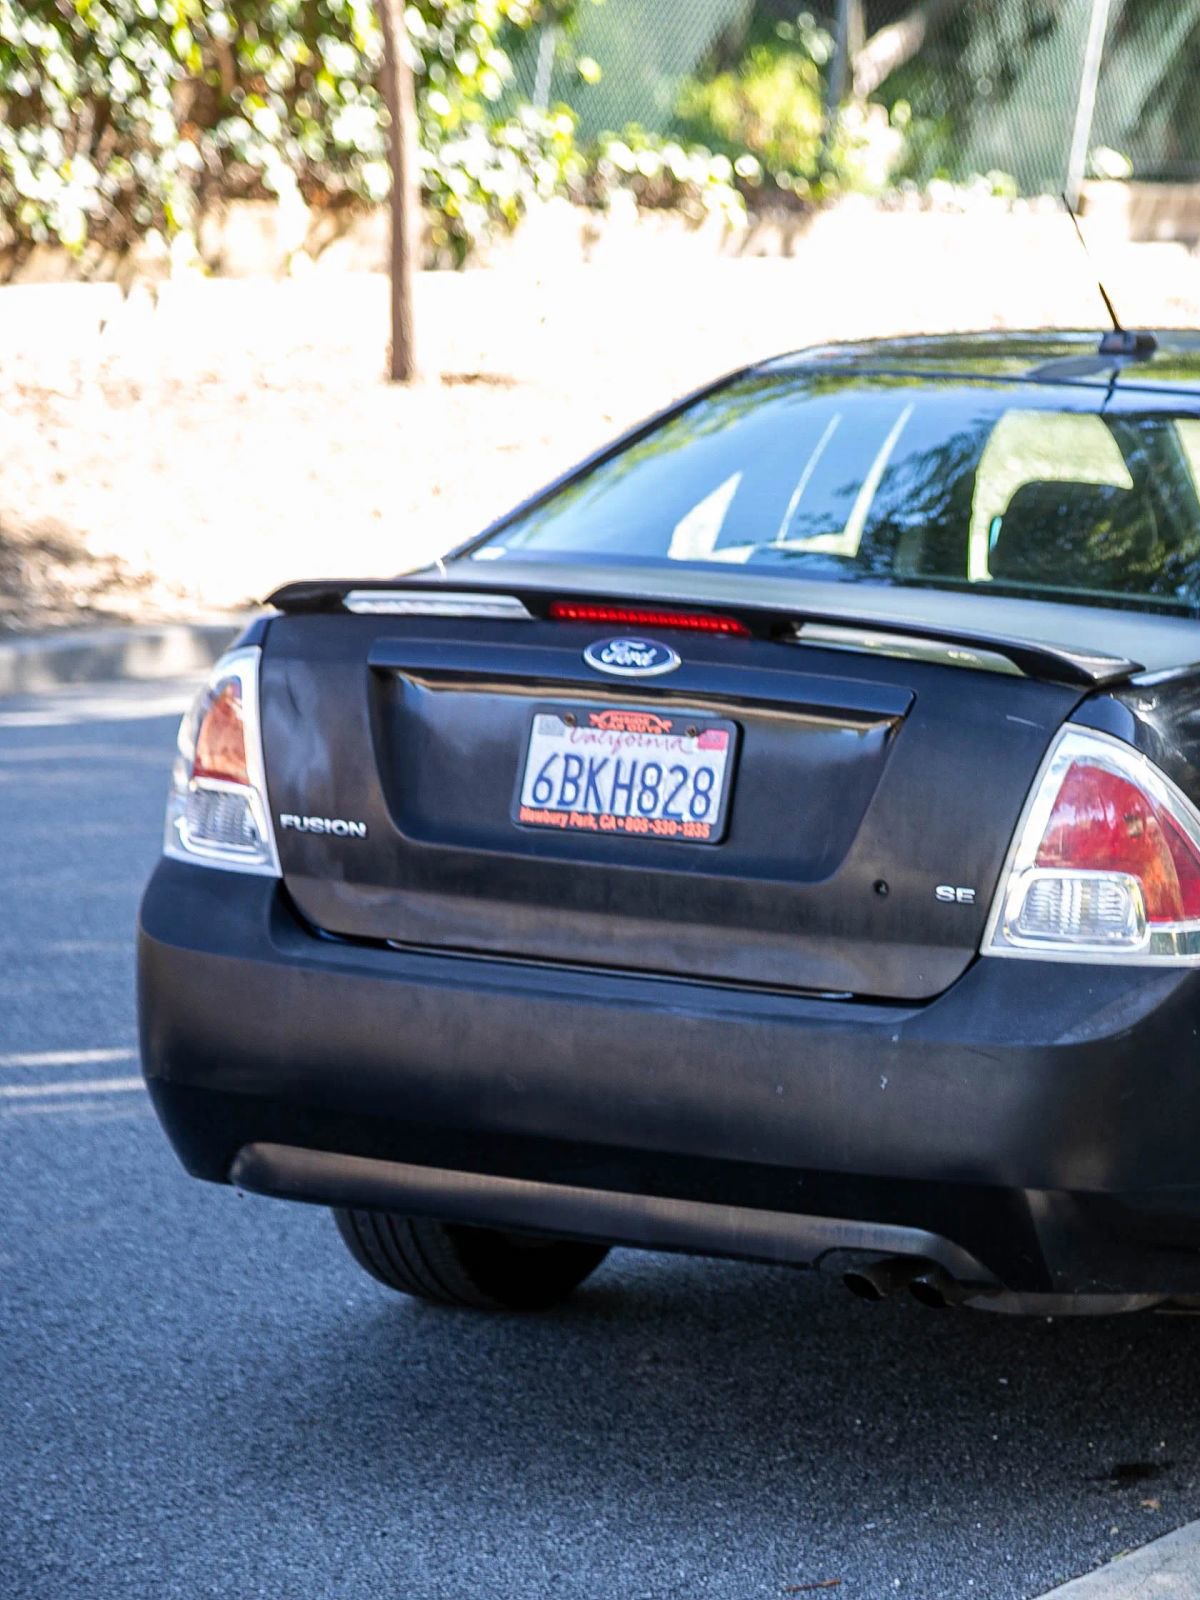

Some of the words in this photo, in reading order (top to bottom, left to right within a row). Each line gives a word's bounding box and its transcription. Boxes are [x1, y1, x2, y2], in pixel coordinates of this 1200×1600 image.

[600, 638, 658, 667] Ford
[568, 726, 694, 755] California
[532, 752, 715, 819] 6BKH828
[279, 813, 368, 839] FUSION
[935, 884, 976, 905] SE
